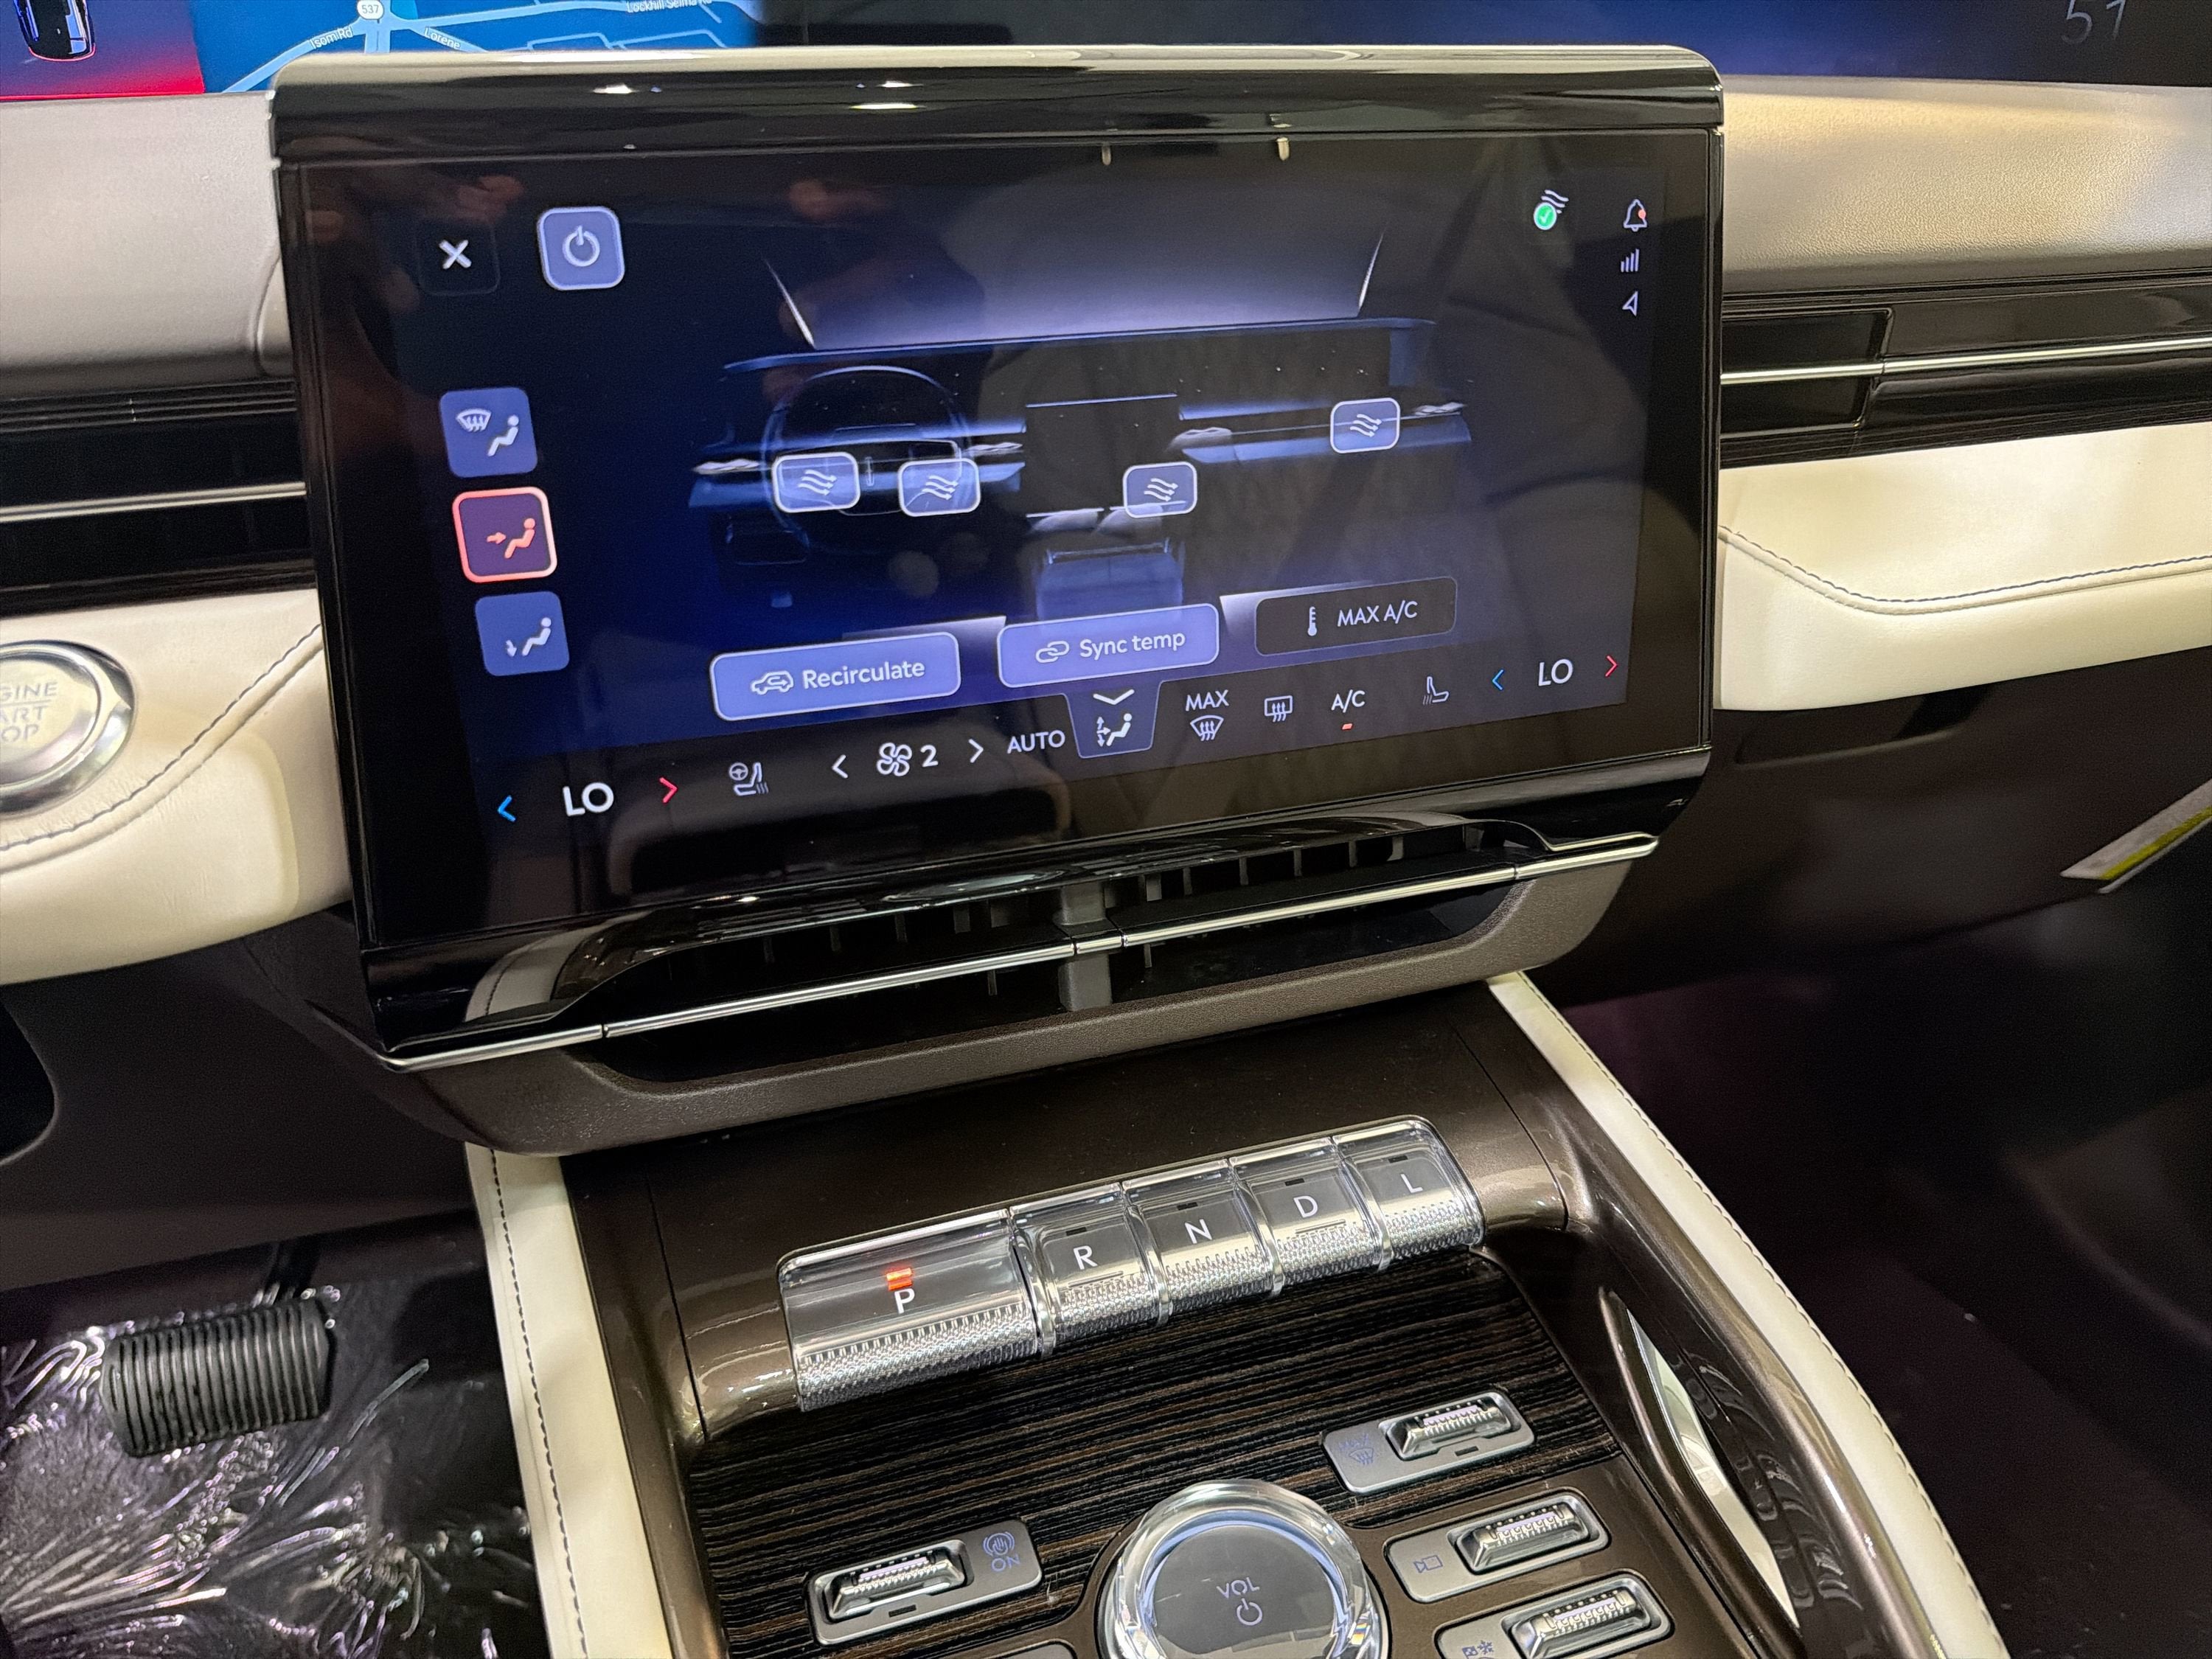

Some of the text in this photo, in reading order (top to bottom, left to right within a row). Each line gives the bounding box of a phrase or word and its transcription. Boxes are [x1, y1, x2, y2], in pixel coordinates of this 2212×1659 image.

[361, 4, 379, 14] 537
[310, 25, 353, 49] Isom Rd
[423, 28, 461, 49] Lorene
[1337, 599, 1418, 627] MAX A/C
[1079, 633, 1186, 661] Sync temp
[802, 661, 925, 689] Recirculate
[1538, 658, 1573, 686] LO
[1185, 689, 1230, 712] MAX
[1331, 689, 1366, 713] A/C
[1007, 729, 1065, 754] AUTO
[920, 745, 939, 768] 2
[563, 782, 614, 817] LO
[1400, 1173, 1424, 1194] L
[1293, 1195, 1318, 1218] D
[1184, 1218, 1213, 1245] N
[1073, 1245, 1099, 1270] R
[894, 1287, 915, 1314] P
[991, 1553, 1020, 1572] ON
[1216, 1576, 1260, 1599] VOL
